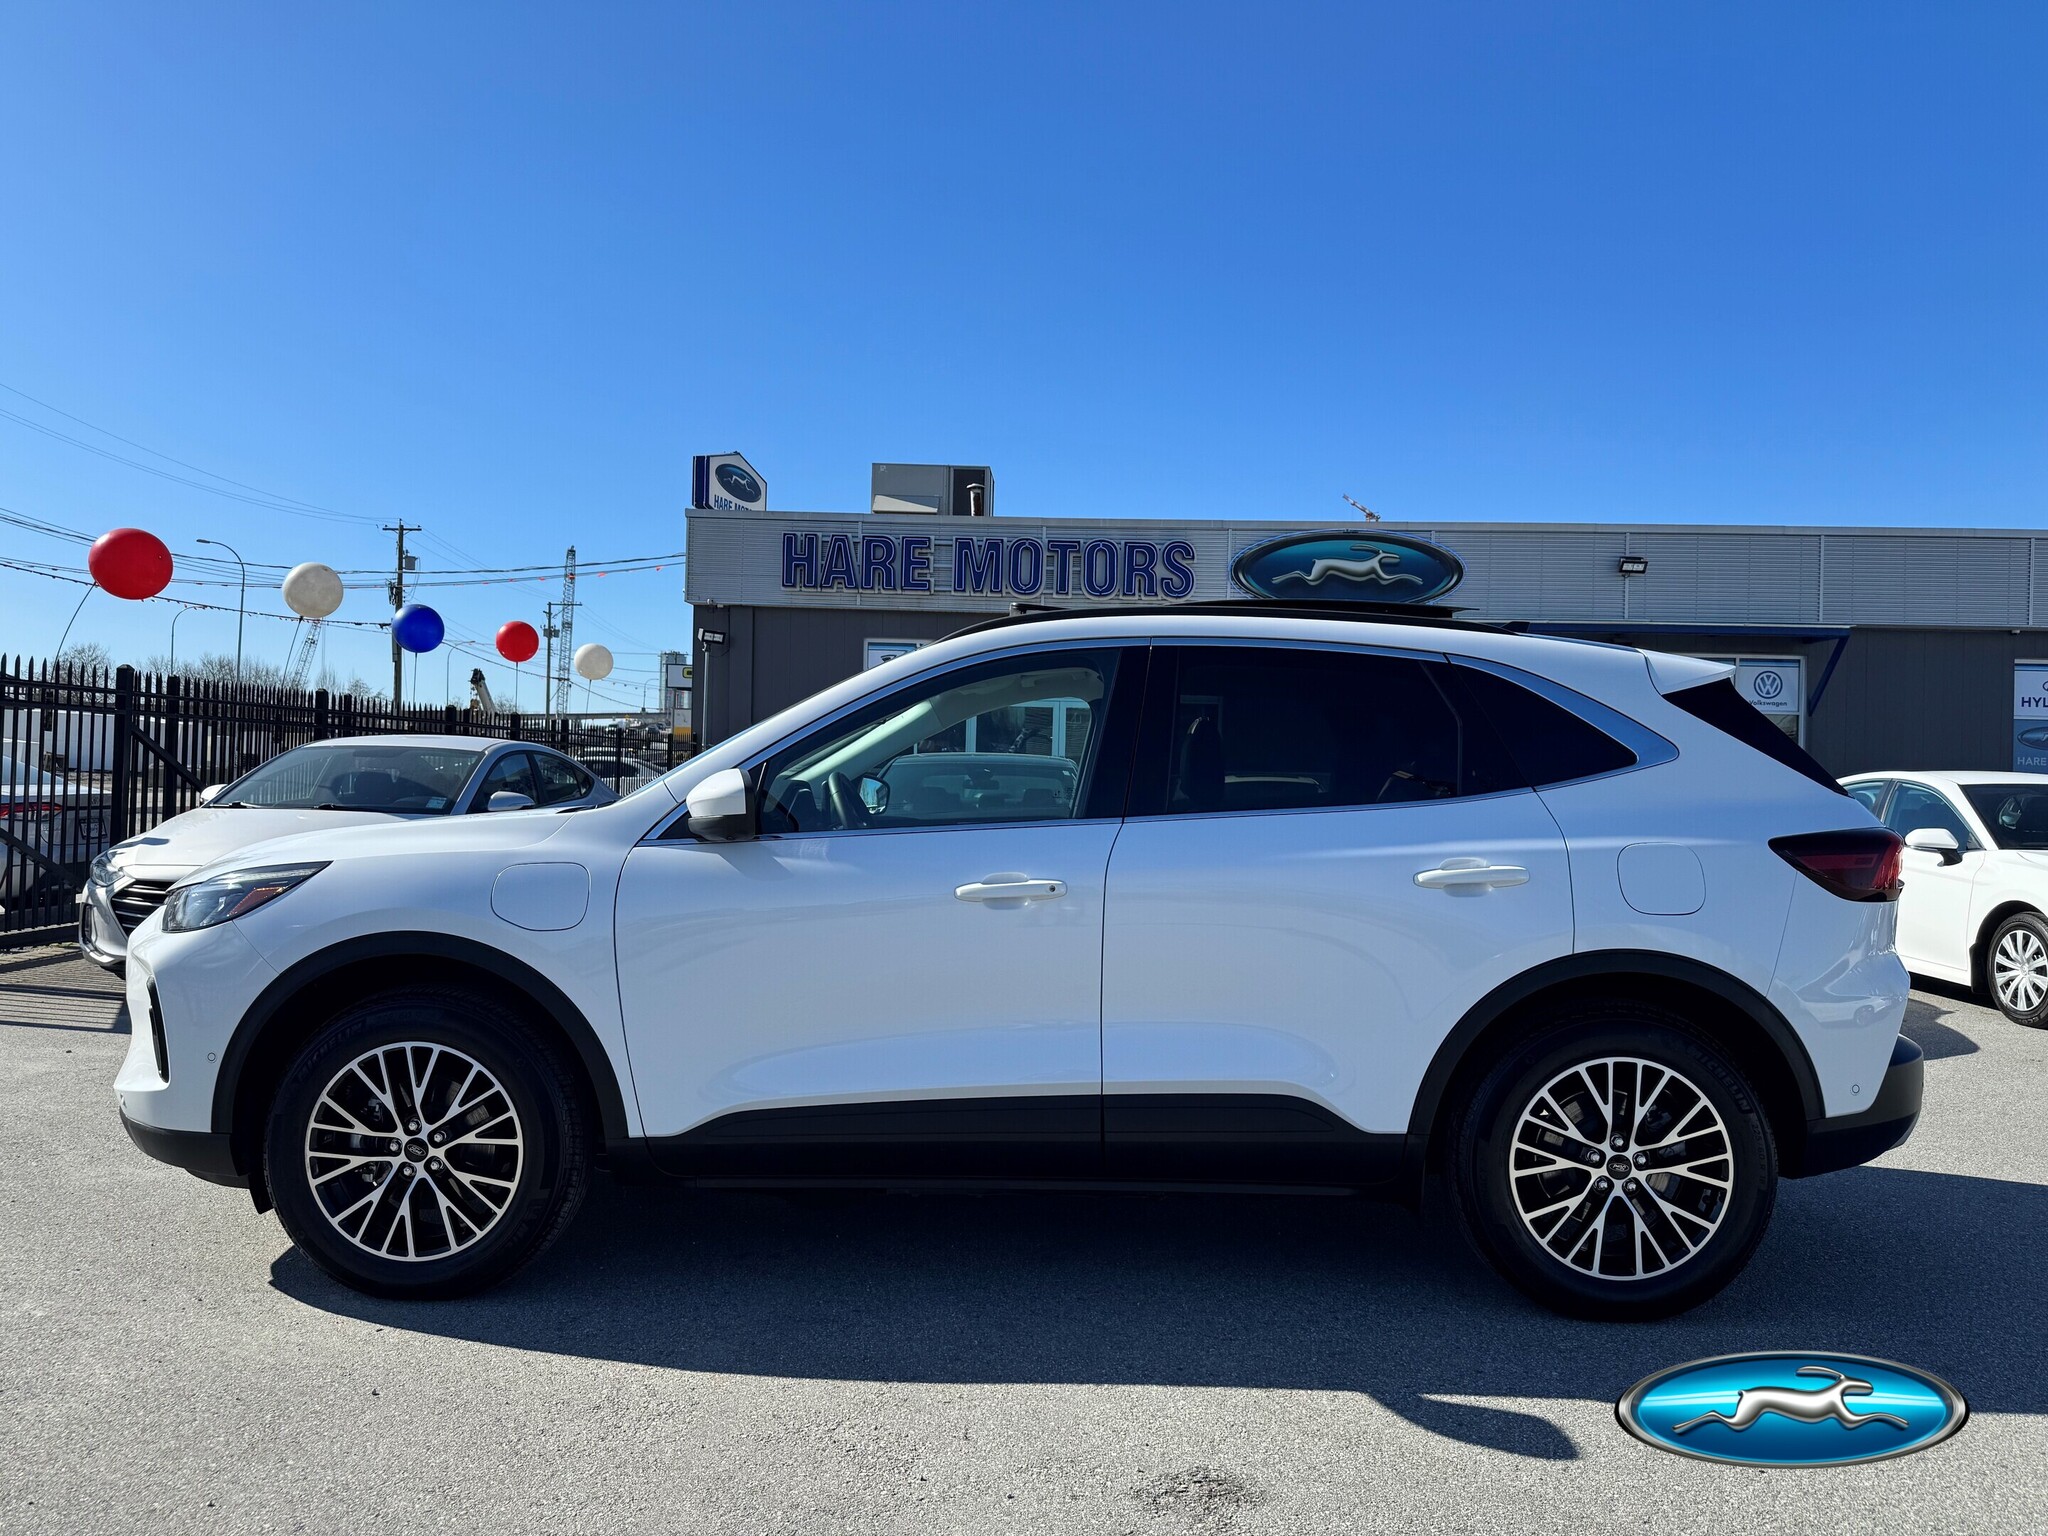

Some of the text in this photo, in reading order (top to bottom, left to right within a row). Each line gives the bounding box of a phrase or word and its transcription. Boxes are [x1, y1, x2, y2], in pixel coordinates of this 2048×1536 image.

[714, 494, 733, 510] HARE
[781, 532, 1196, 598] HARE MOTORS
[2017, 757, 2047, 766] HARE
[1688, 1046, 1752, 1114] MICHELIN
